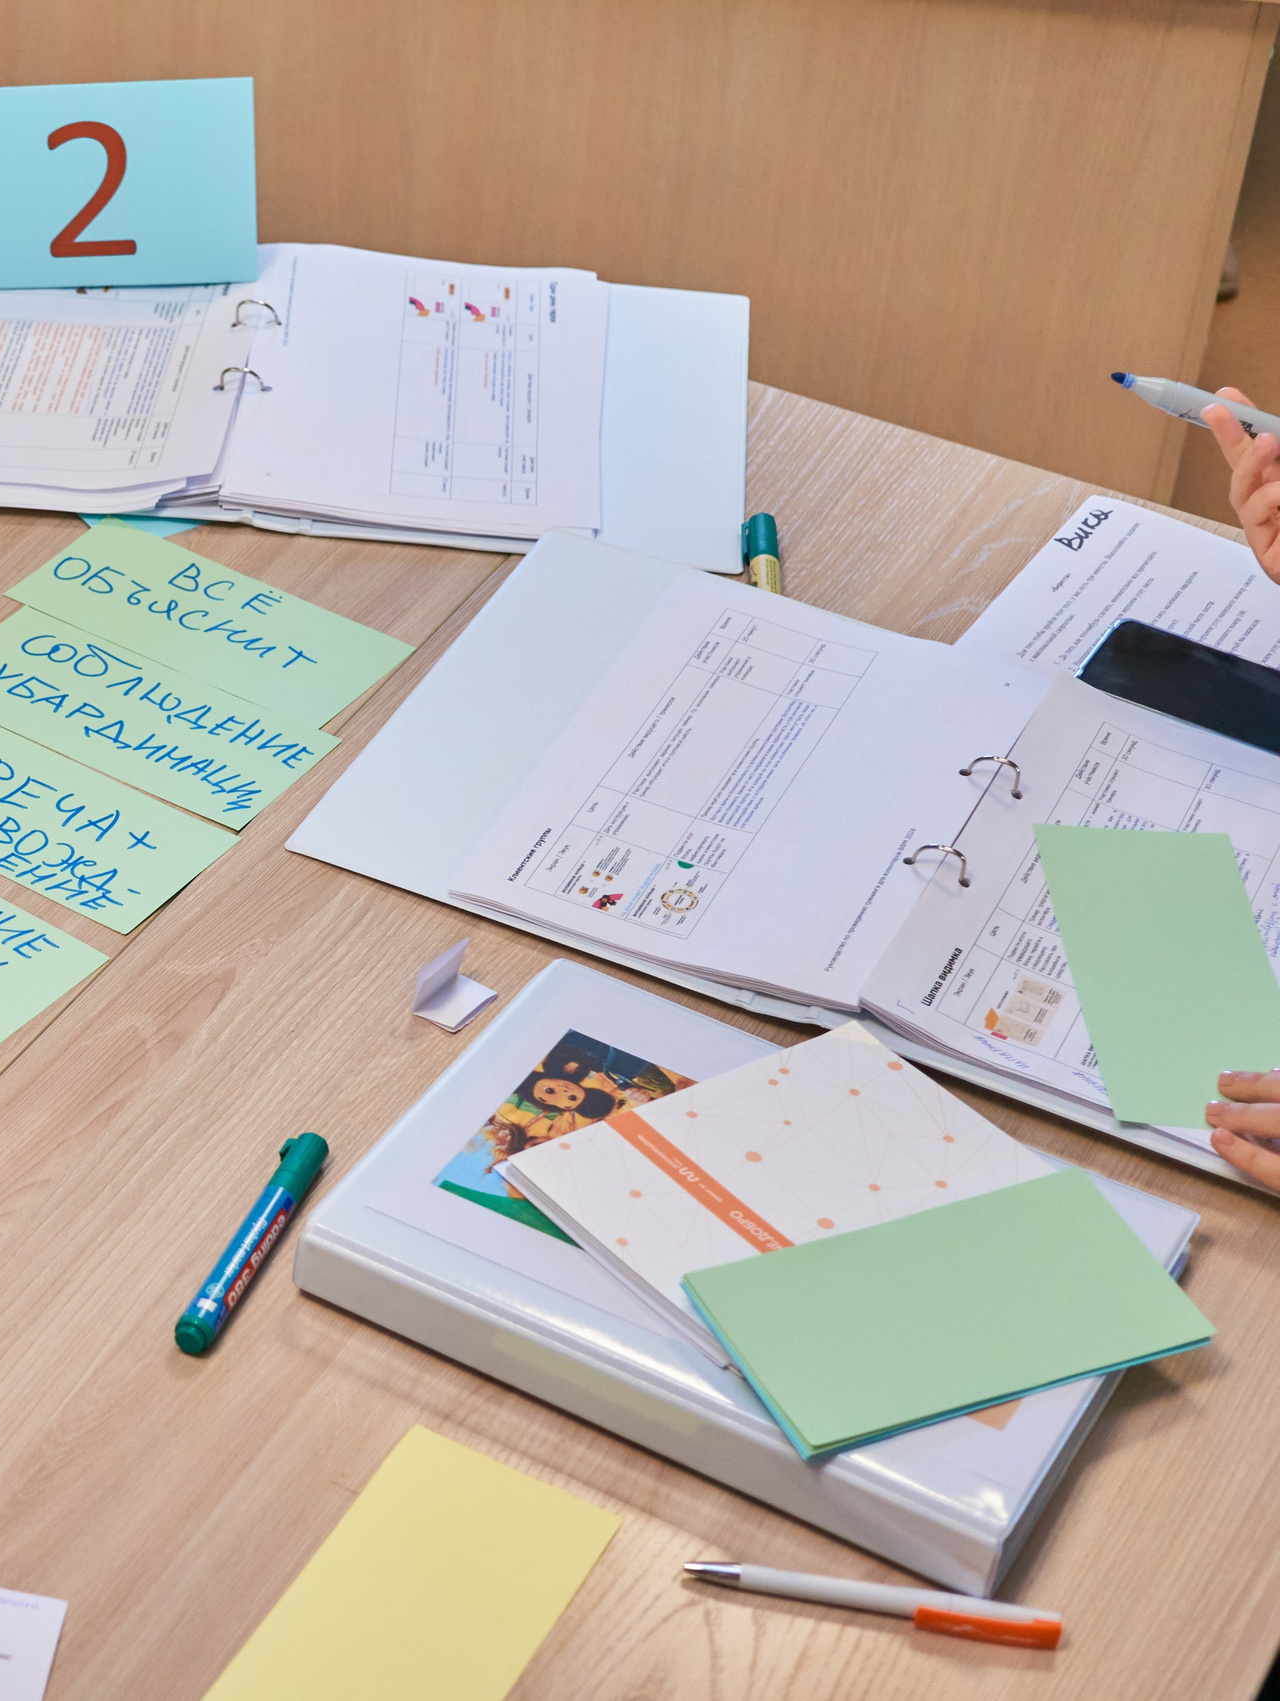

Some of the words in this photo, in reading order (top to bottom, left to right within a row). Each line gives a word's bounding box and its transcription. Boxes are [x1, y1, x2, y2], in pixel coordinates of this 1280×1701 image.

[47, 120, 137, 258] 2
[1053, 509, 1114, 552] Вика
[21, 634, 314, 770] СОБЛЮДЕНИЕ
[506, 848, 537, 882] Клиентские
[532, 826, 554, 849] группы
[920, 977, 944, 1007] Шапка
[936, 945, 964, 982] видимка
[247, 1212, 288, 1268] edding
[223, 1267, 254, 1308] 380
